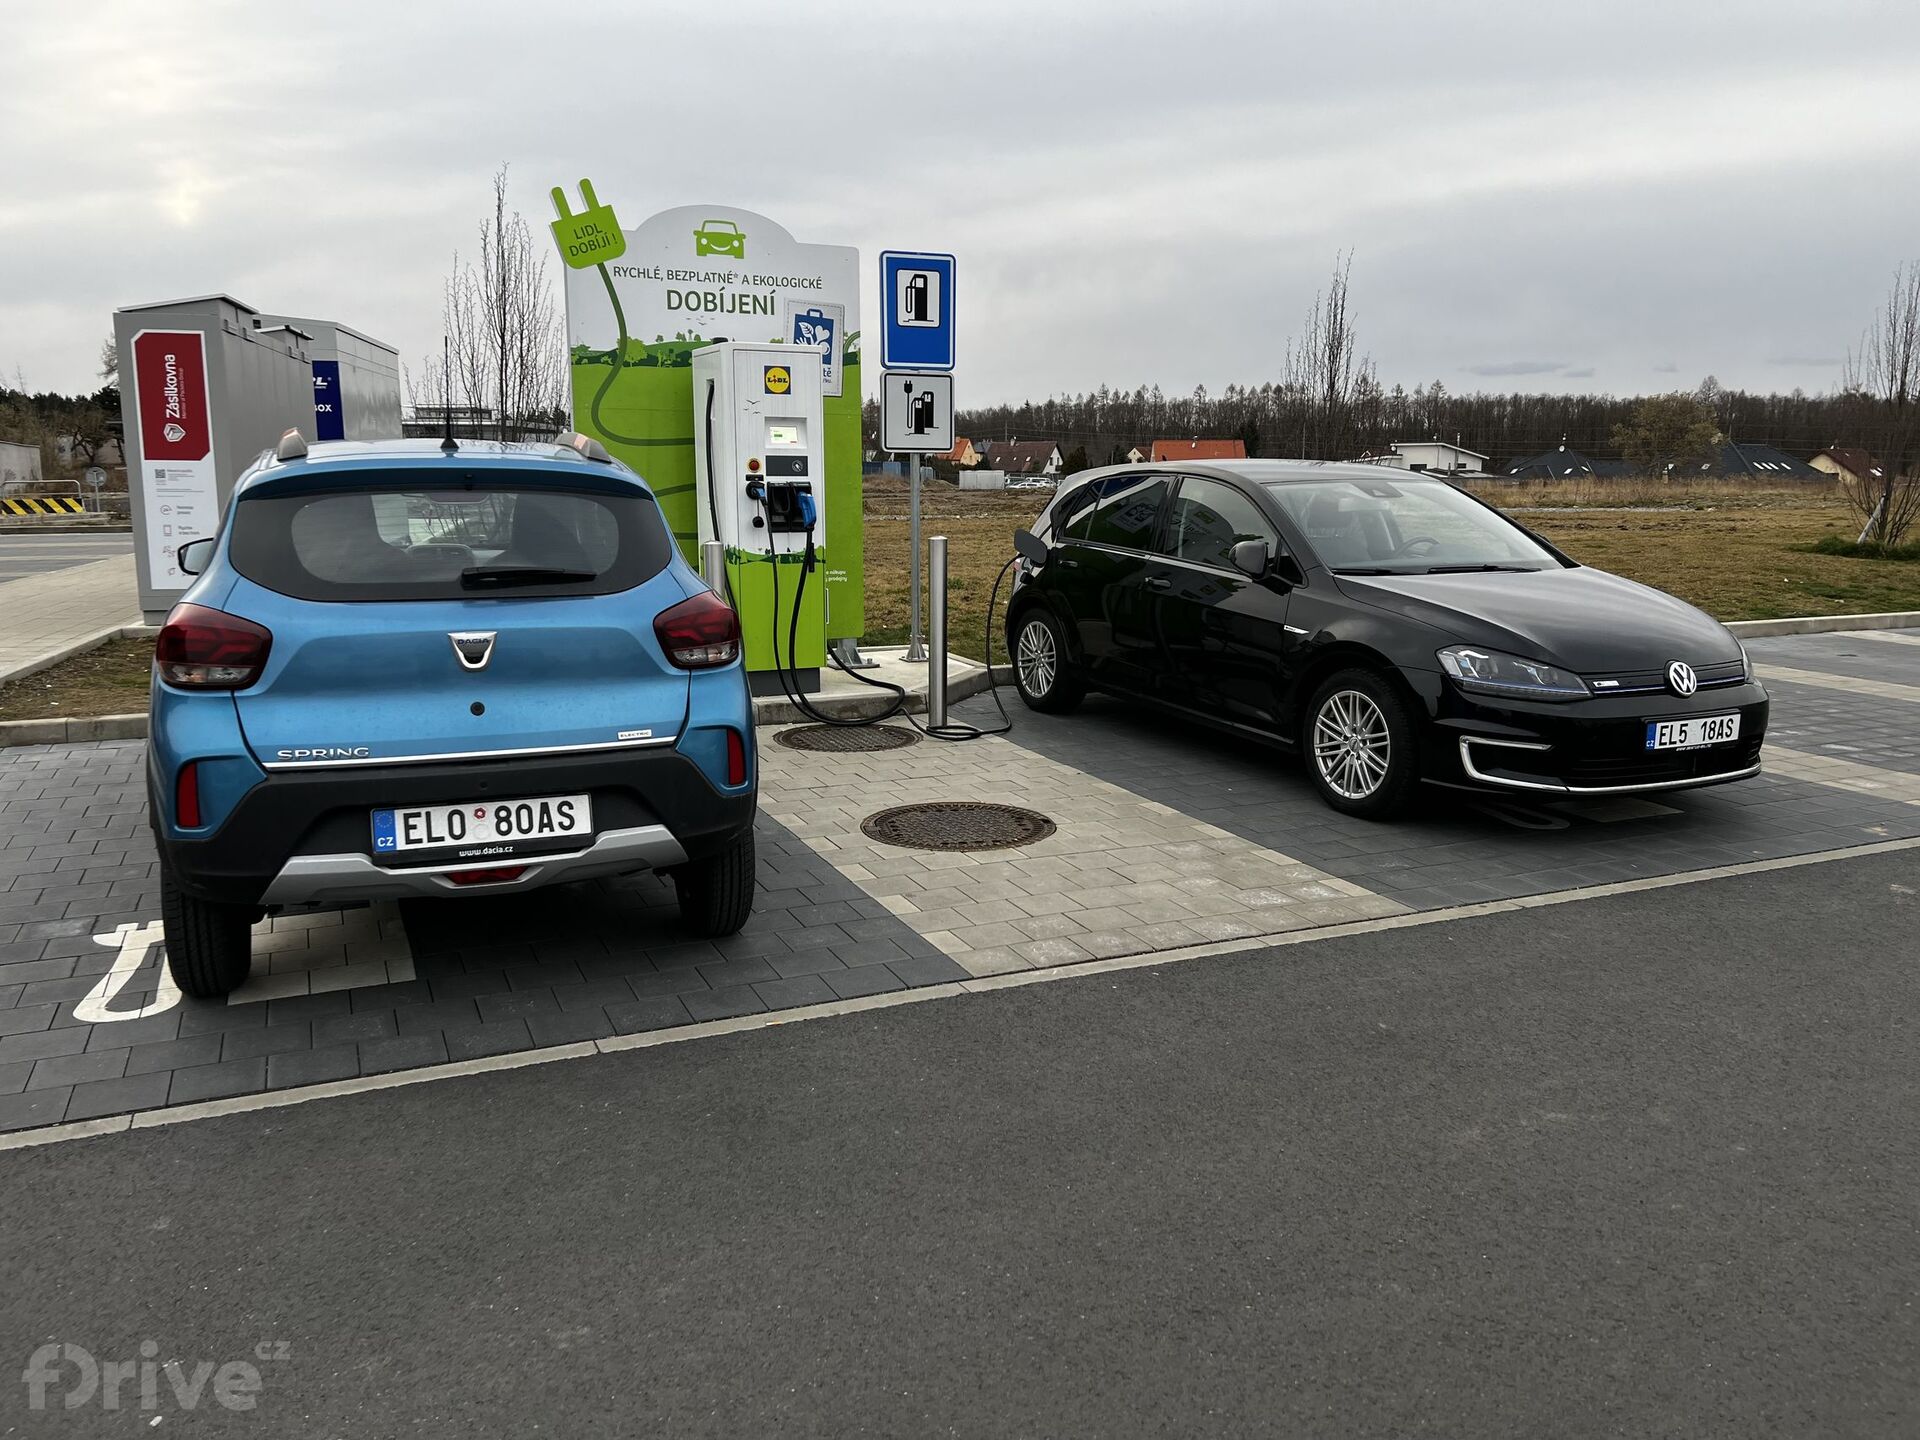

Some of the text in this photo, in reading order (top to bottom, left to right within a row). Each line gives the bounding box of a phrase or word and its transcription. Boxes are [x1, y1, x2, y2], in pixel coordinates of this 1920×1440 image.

[569, 231, 611, 257] DOBÍJÍ
[573, 223, 603, 240] LIDL
[613, 265, 664, 282] RYCHLÉ,
[741, 274, 750, 285] A
[752, 275, 823, 290] EKOLOGICKÉ
[666, 285, 776, 316] DOBÍJENÍ
[164, 354, 180, 419] Zásilkovna
[1659, 723, 1689, 746] EL5
[1701, 718, 1734, 742] 18AS
[277, 747, 369, 760] SPRING
[377, 836, 394, 848] CZ
[494, 800, 575, 837] 80AS
[459, 846, 513, 857] www.dacia.cz
